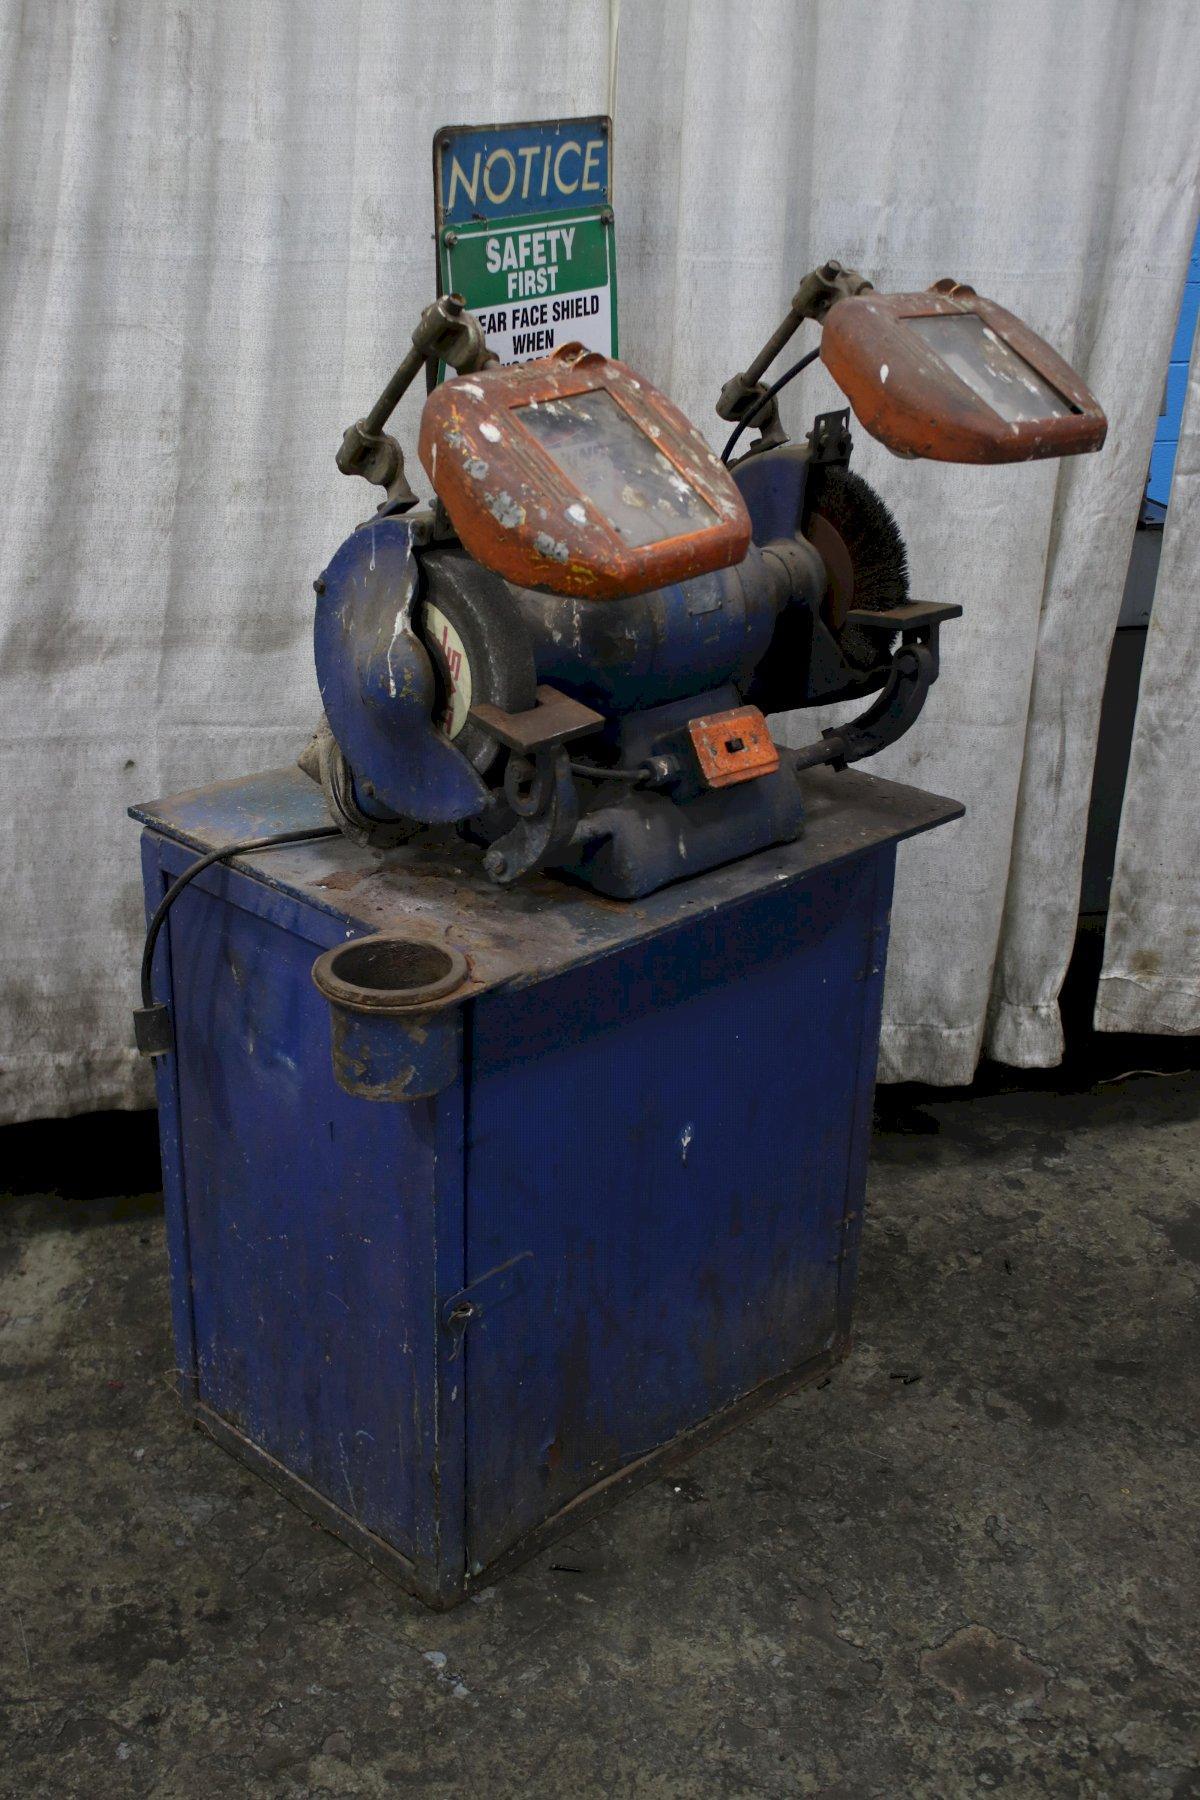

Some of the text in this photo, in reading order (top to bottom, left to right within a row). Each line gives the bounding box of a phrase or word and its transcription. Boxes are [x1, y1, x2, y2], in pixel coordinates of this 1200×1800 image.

[448, 141, 604, 209] NOTICE
[486, 227, 576, 273] SAFETY
[507, 265, 559, 299] FIRST
[477, 295, 599, 335] EAR FACE SHIELD
[512, 329, 555, 356] WHEN
